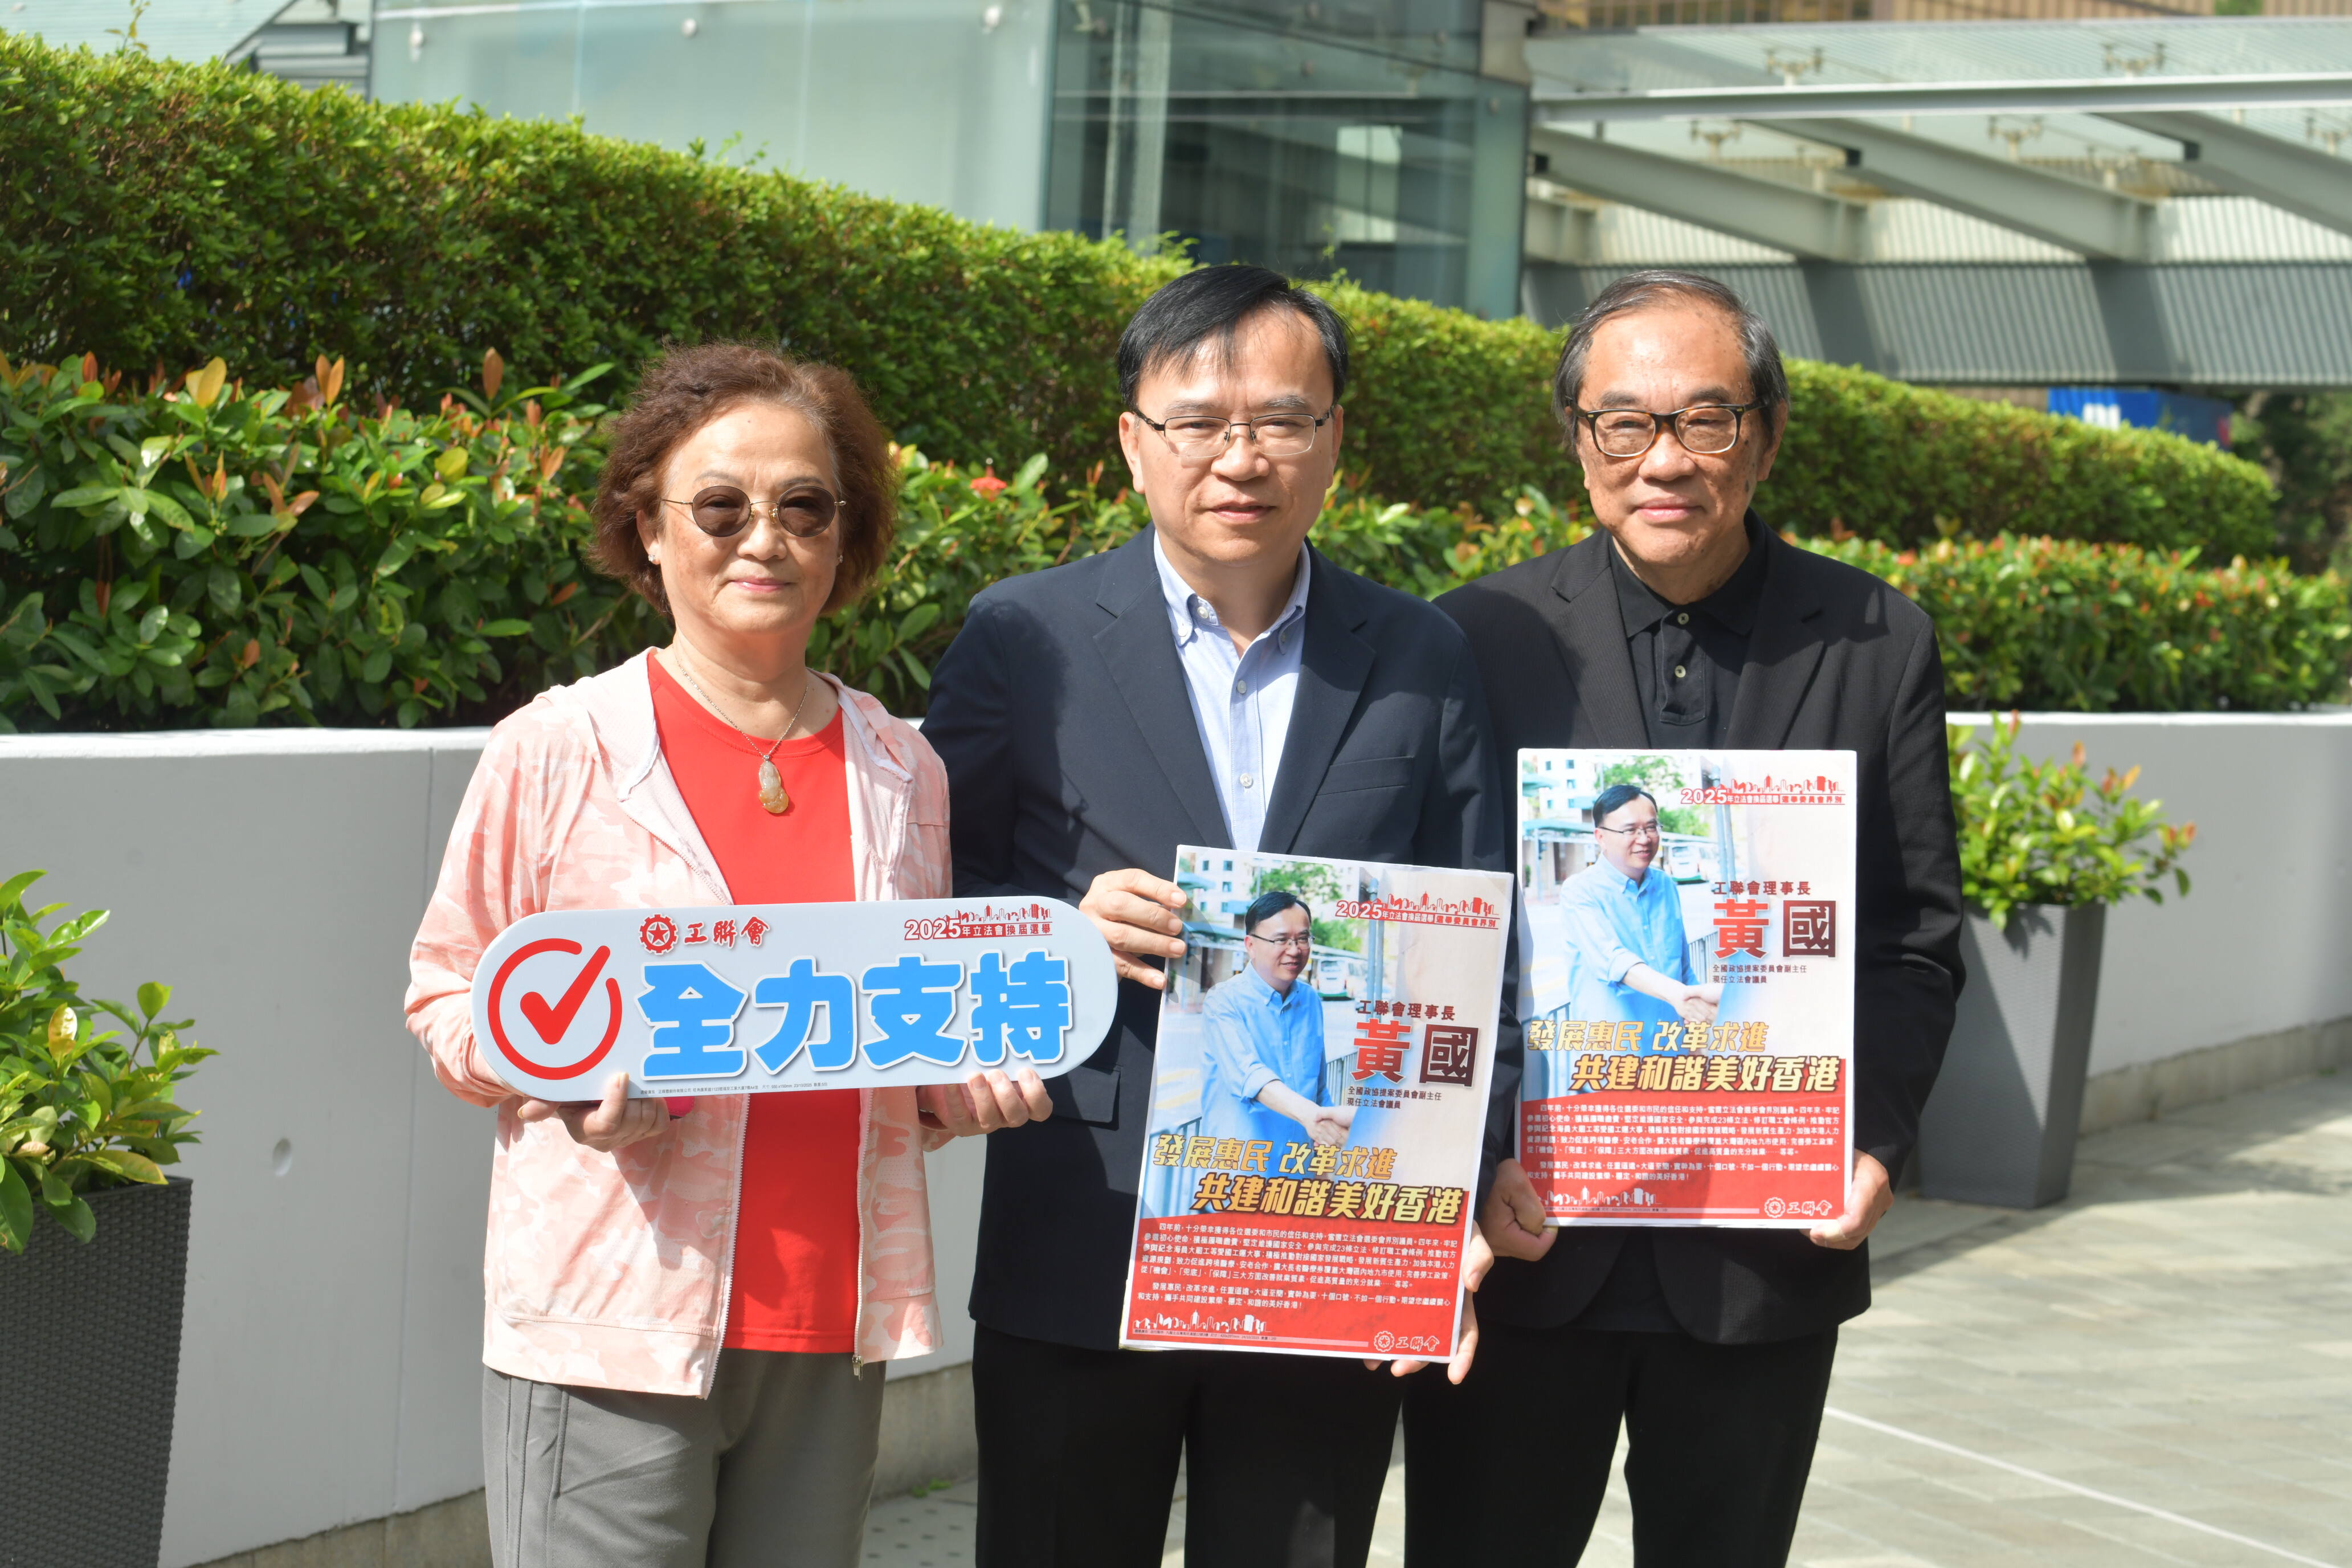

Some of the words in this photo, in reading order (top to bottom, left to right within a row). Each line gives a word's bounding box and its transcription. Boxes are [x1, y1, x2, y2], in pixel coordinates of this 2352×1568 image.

[1713, 881, 1811, 896] 工聯會理事長
[684, 917, 769, 947] 工聯會
[1713, 899, 1836, 959] 黃國
[1712, 975, 1767, 984] 現任立法會議員
[1713, 965, 1807, 973] 全國政協提案委員會副主任
[636, 949, 1071, 1079] 全力支持
[1357, 1000, 1455, 1020] 工聯會理事長
[1527, 1020, 1644, 1052] 發展惠民
[1652, 1021, 1769, 1053] 改革求進
[1350, 1018, 1479, 1088] 黃國
[1569, 1055, 1842, 1092] 共建和諧美好香港
[1347, 1098, 1400, 1109] 現任立法會議員
[1348, 1087, 1442, 1101] 全國政協提案委員會副主任
[1153, 1134, 1273, 1172] 發展惠民
[1278, 1142, 1397, 1179] 改革求進
[1190, 1172, 1463, 1224] 共建和諧美好香港
[1787, 1199, 1832, 1215] 工聯會
[1396, 1336, 1440, 1351] 工聯會
